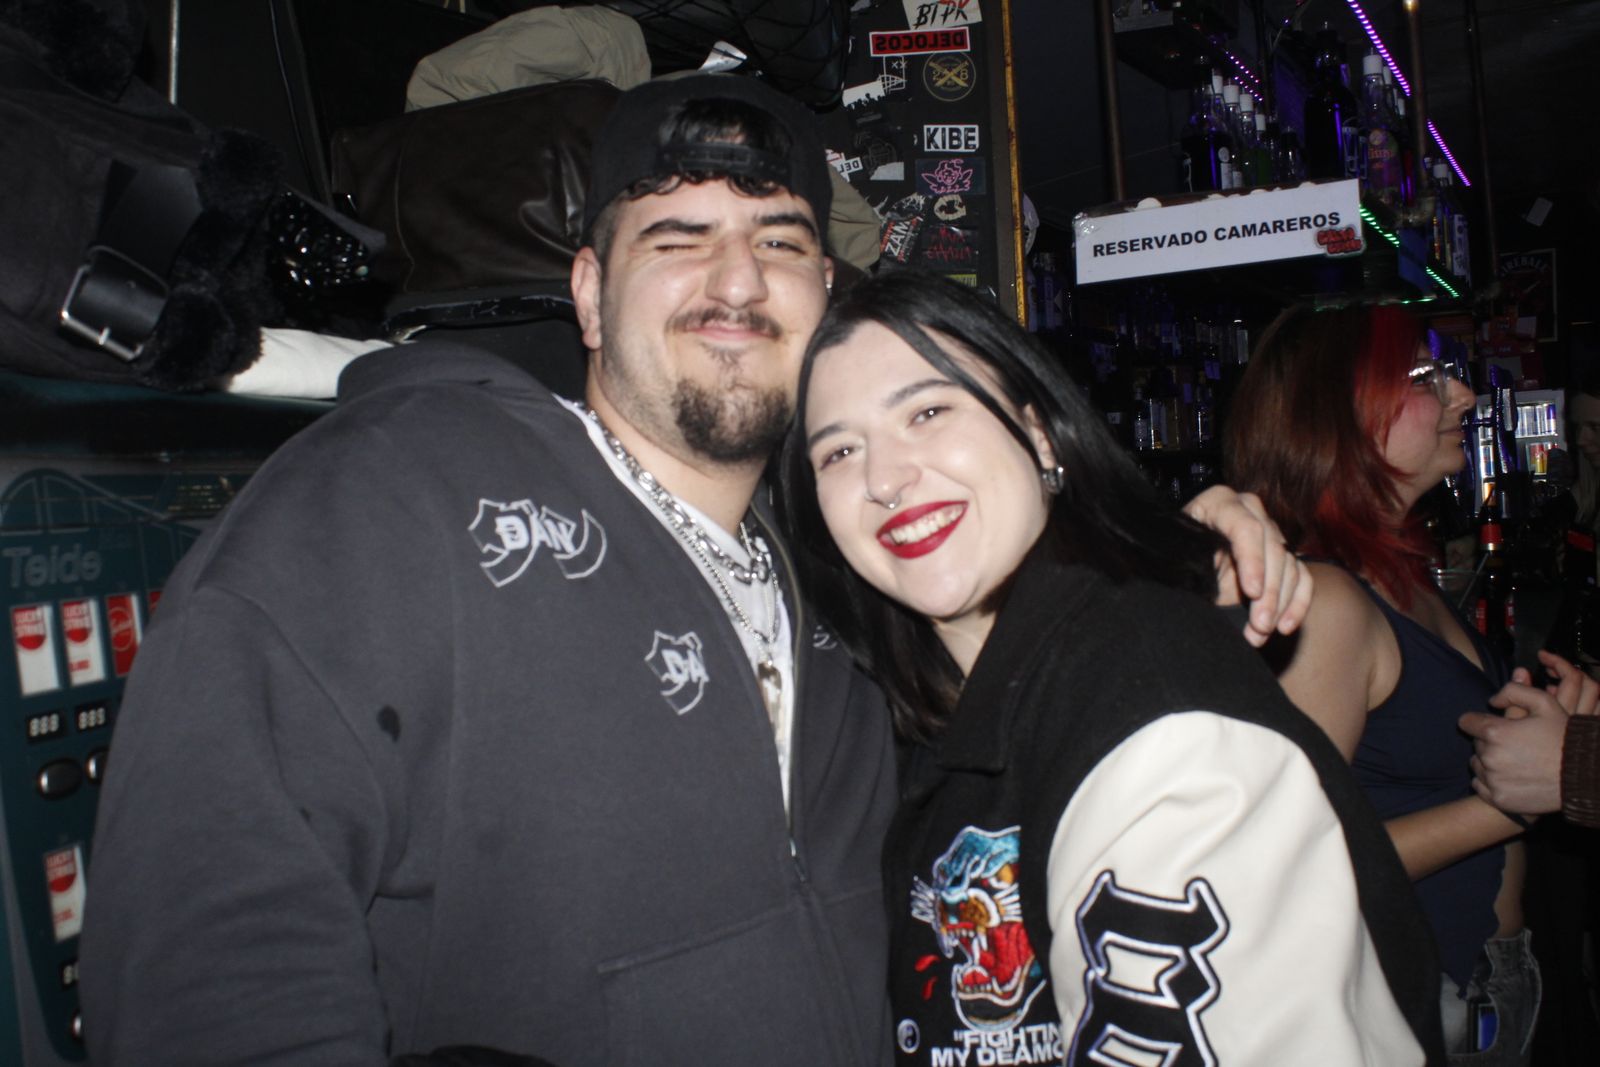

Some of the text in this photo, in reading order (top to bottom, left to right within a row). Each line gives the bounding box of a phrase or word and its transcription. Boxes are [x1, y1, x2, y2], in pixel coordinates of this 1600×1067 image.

[927, 127, 977, 150] KIBE
[1093, 230, 1207, 257] RESERVADO
[1214, 212, 1340, 241] CAMAREROS
[1, 542, 103, 588] Telde
[930, 1047, 971, 1067] MY
